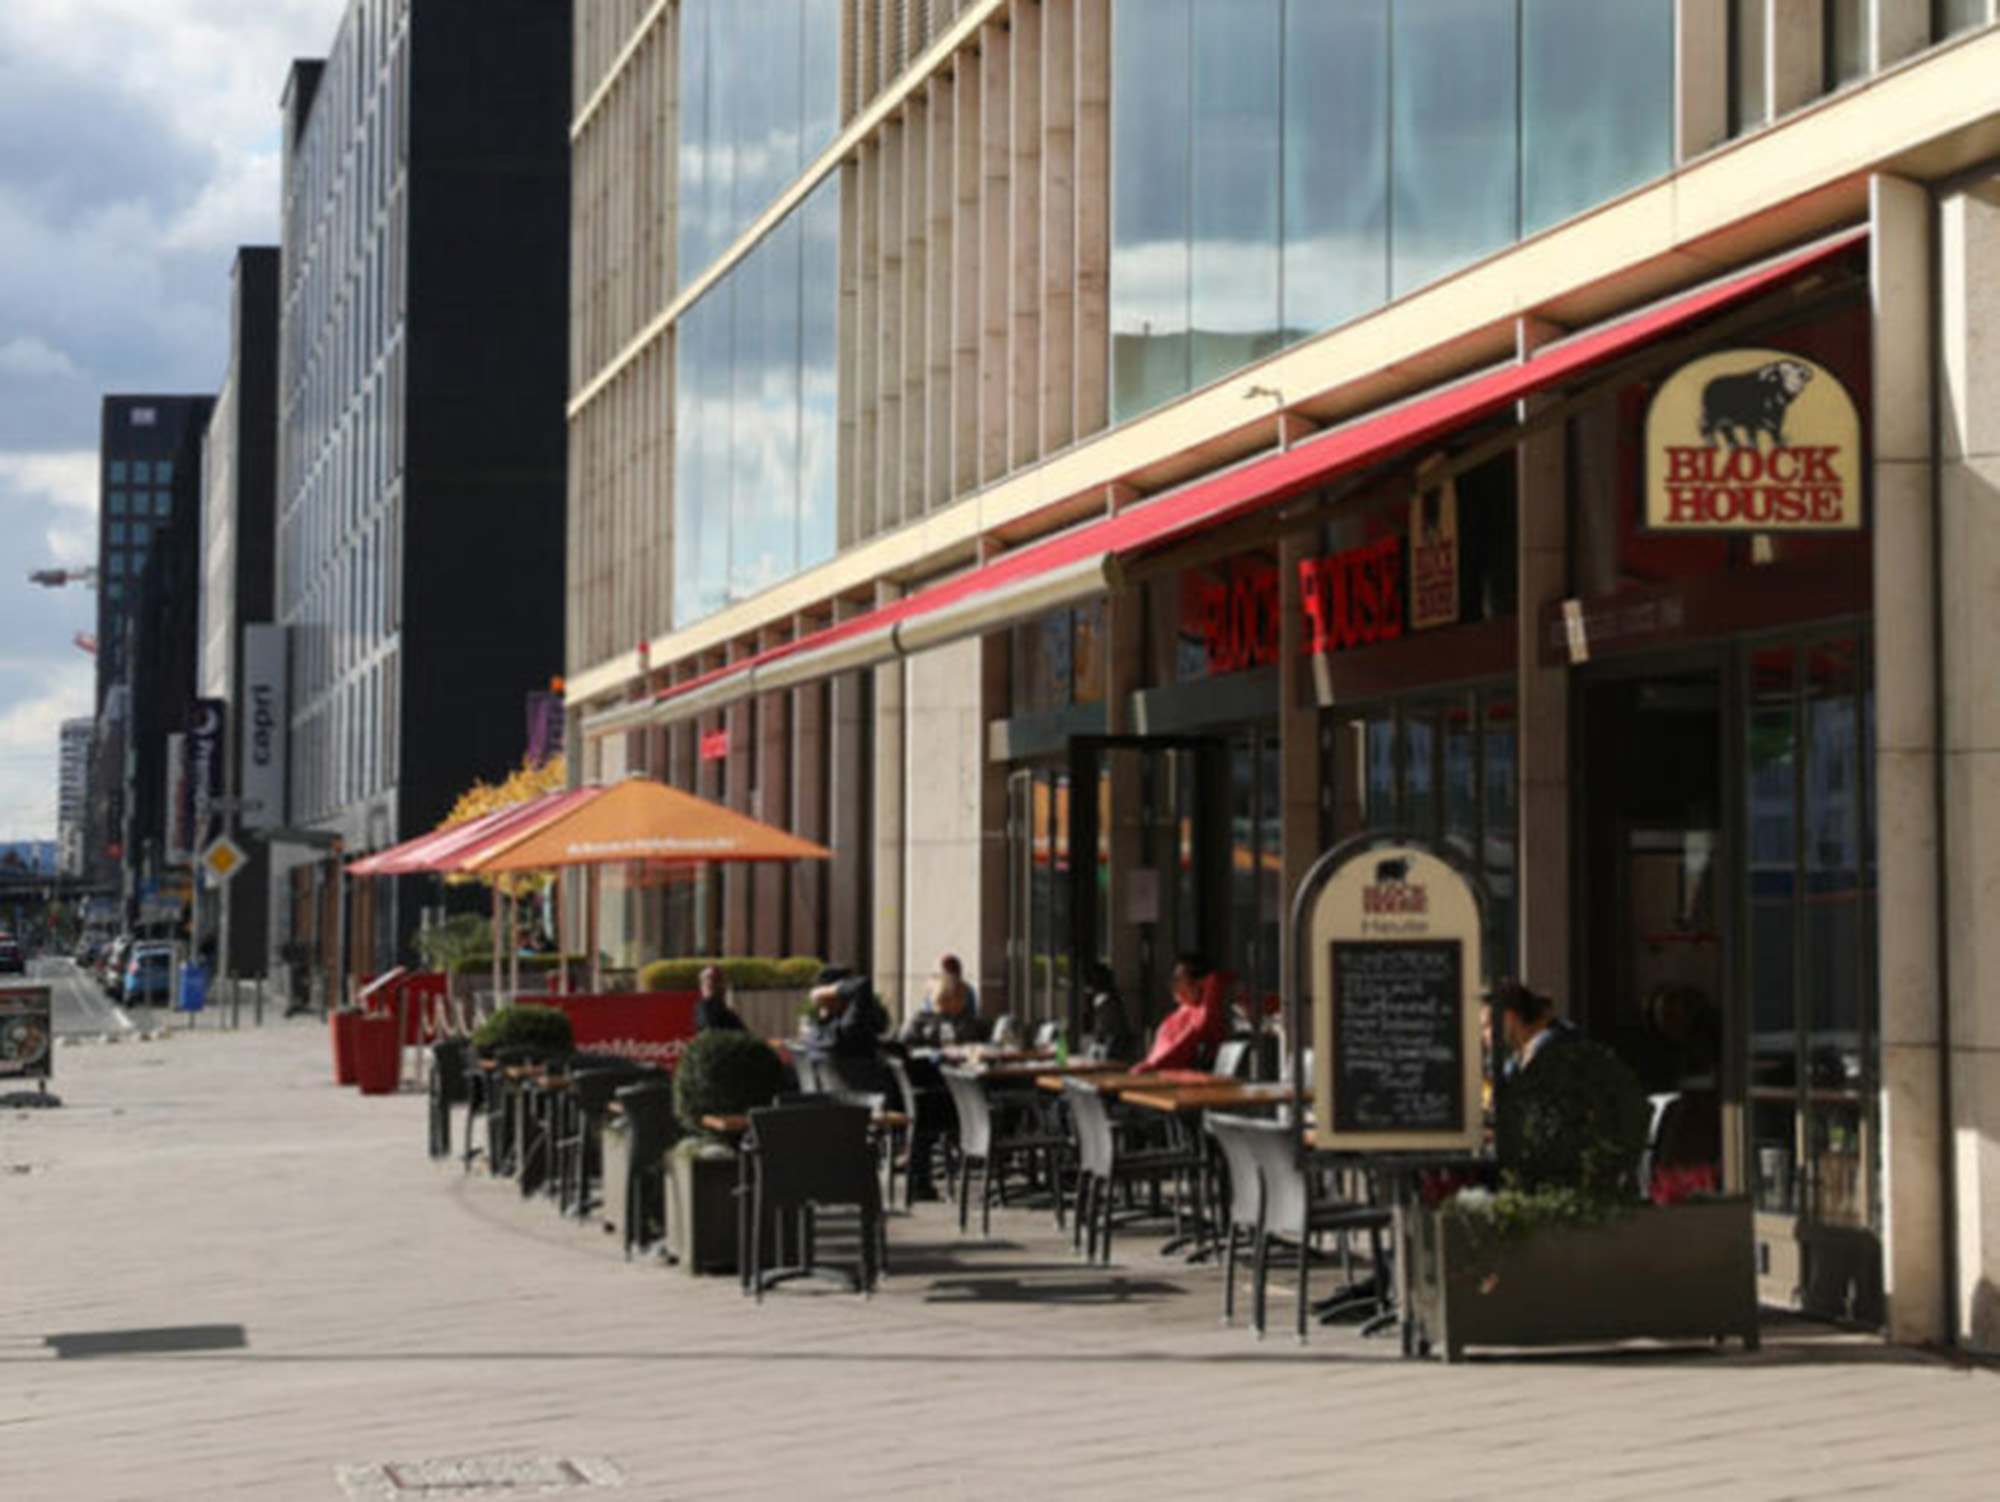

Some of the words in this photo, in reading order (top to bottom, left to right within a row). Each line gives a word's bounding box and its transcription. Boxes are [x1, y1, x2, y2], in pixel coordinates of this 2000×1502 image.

[1664, 446, 1841, 483] BLOCK
[1664, 485, 1843, 523] HOUSE
[251, 684, 275, 767] capri
